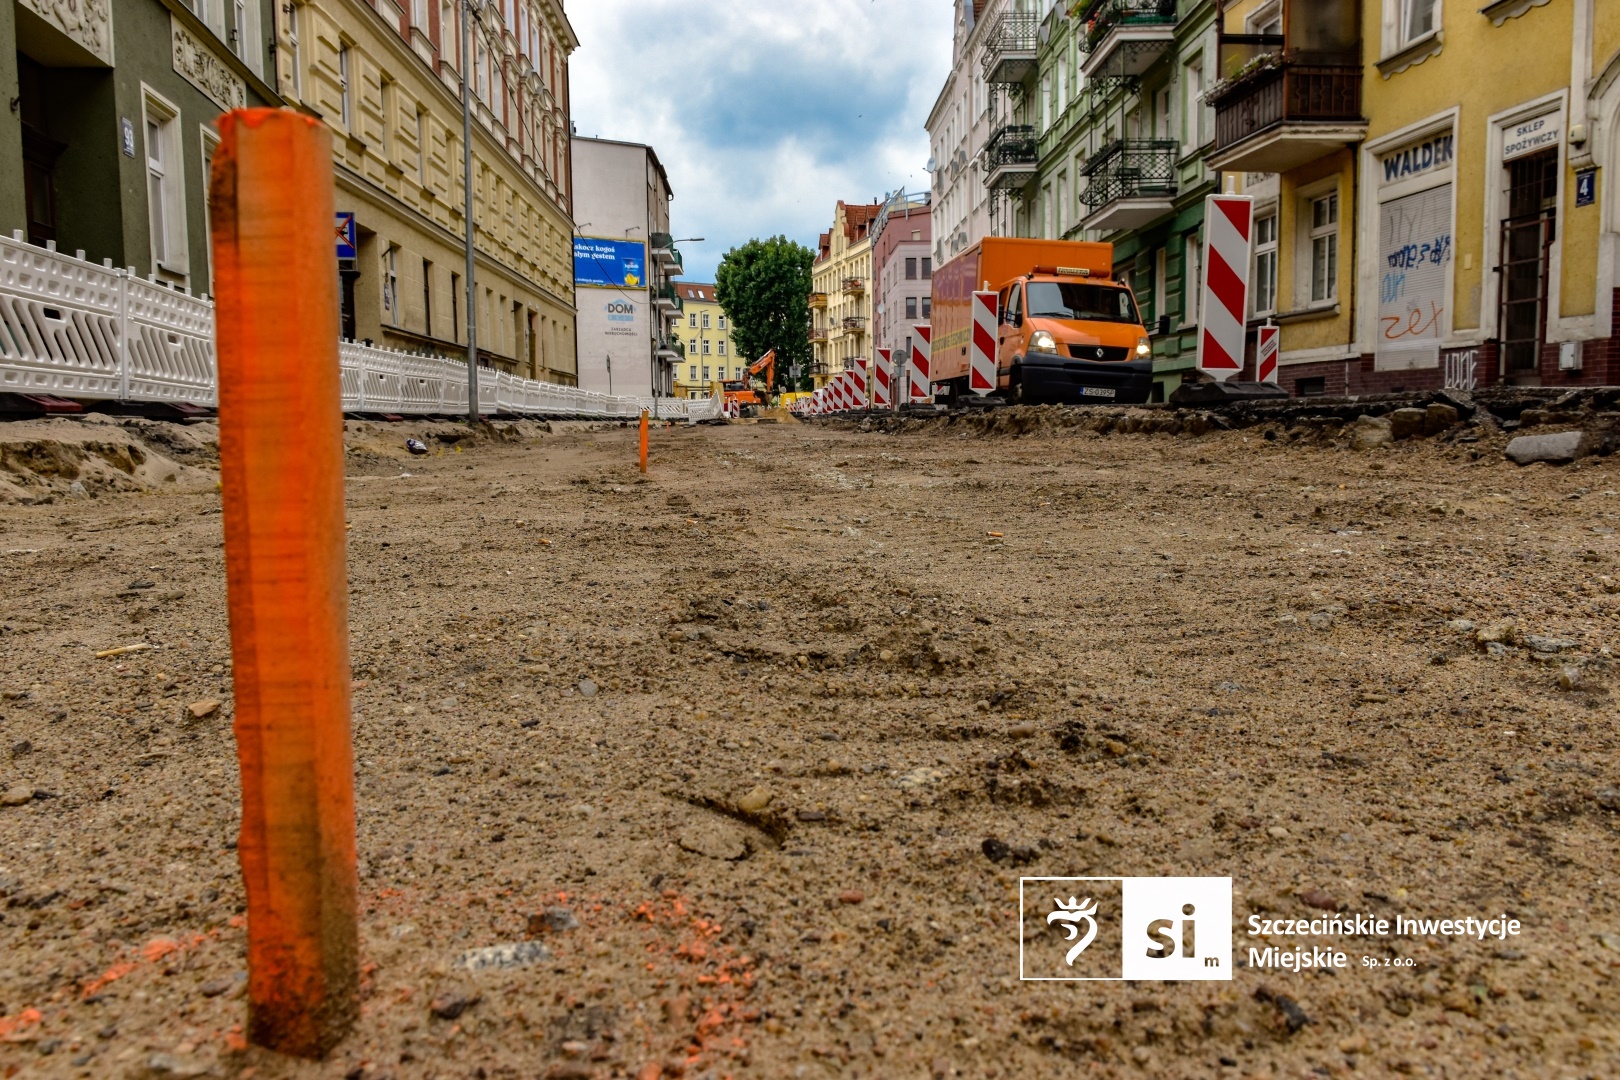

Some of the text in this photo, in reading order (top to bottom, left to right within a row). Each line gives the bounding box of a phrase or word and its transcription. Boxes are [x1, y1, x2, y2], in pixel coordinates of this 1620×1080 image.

[1516, 120, 1544, 136] SKLEP
[1505, 129, 1559, 154] SPOŻYWCZY
[1384, 135, 1453, 181] WALDEK
[1579, 178, 1588, 195] 4
[591, 252, 615, 260] gestem
[595, 245, 615, 253] kogoś
[608, 303, 633, 314] DOM
